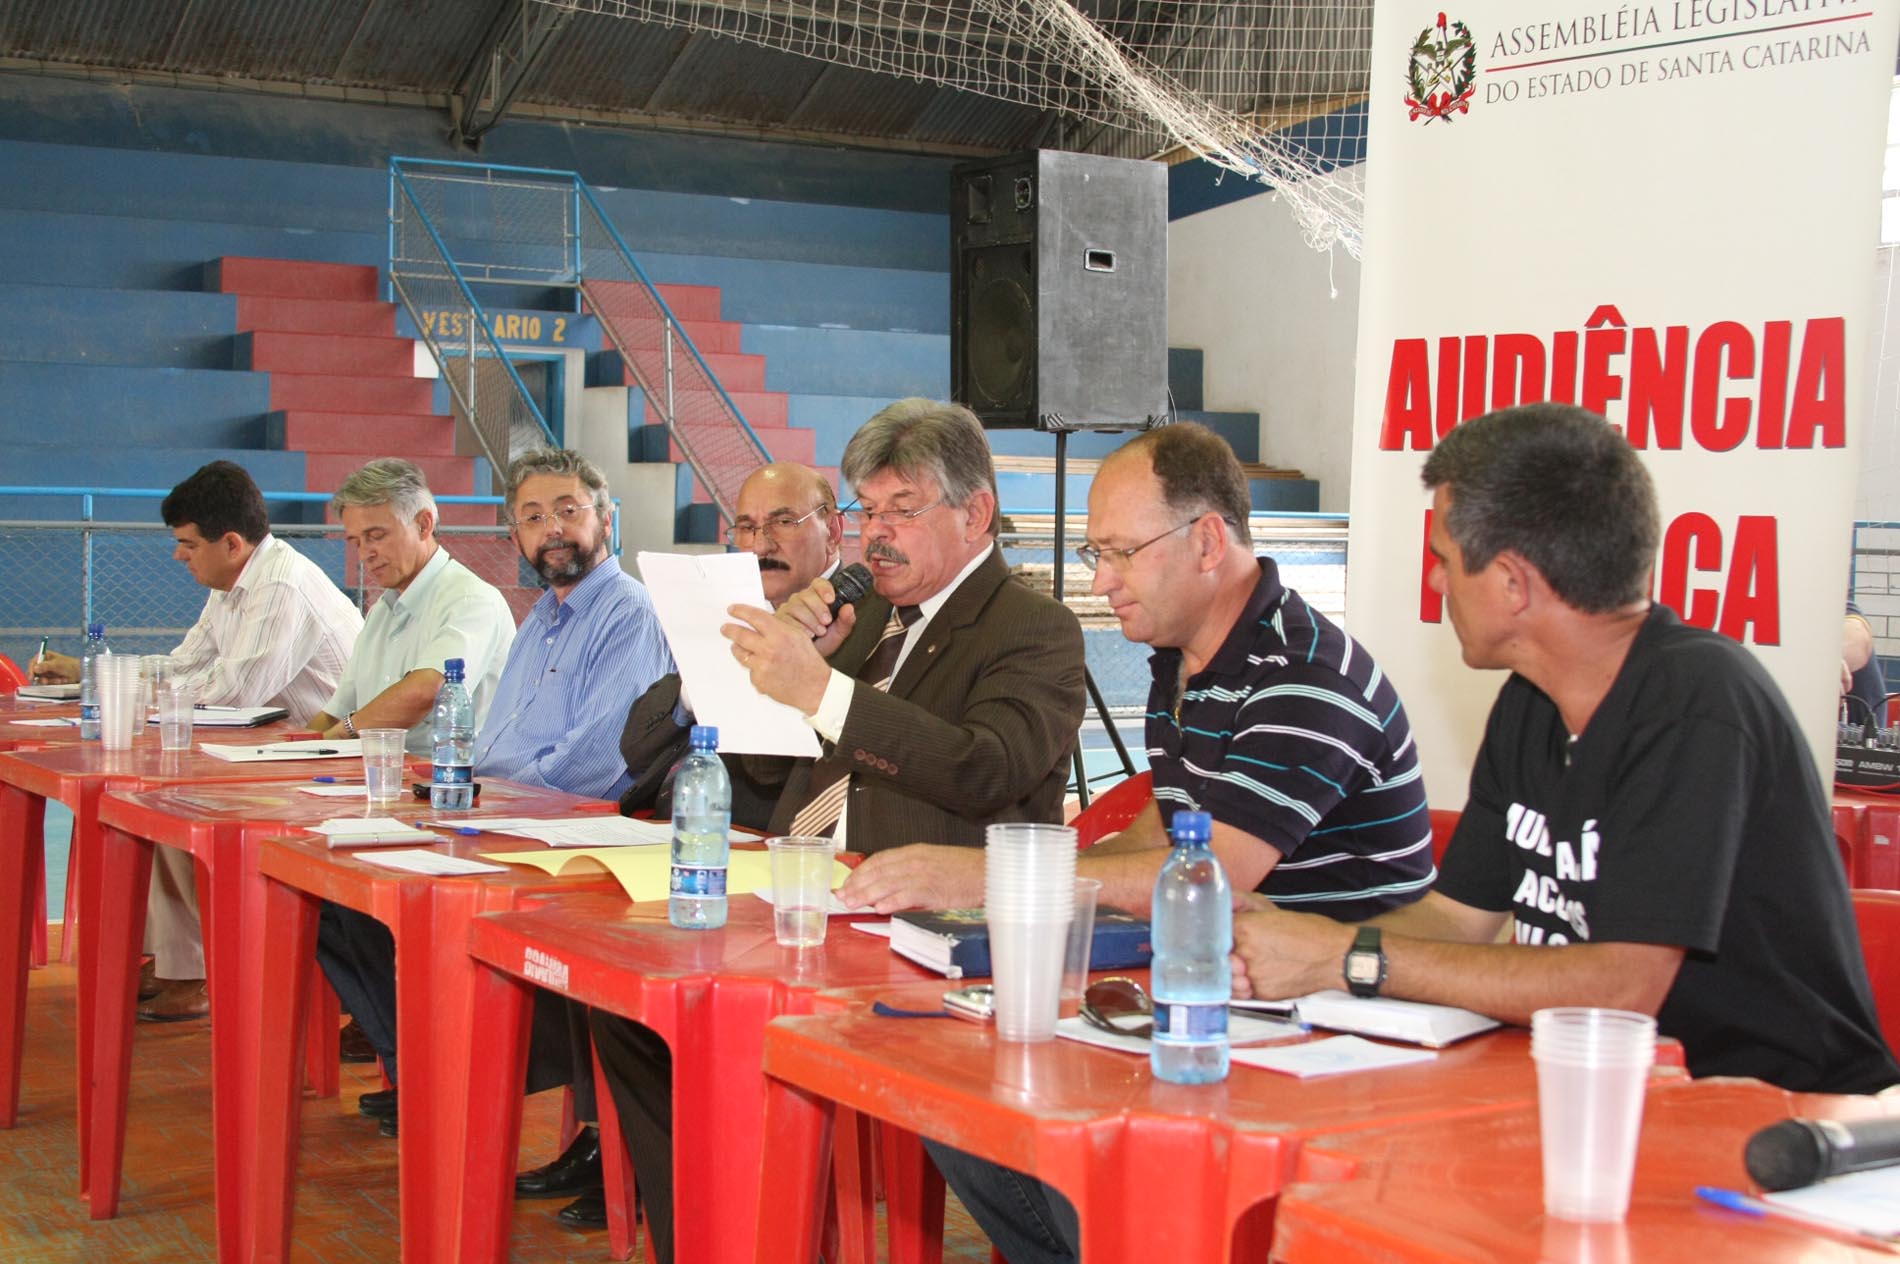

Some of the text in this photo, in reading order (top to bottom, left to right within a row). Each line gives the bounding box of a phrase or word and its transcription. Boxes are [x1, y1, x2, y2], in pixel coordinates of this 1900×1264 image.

[1490, 0, 1858, 59] ASSEMBLÉIA LEGISLA
[1486, 30, 1871, 105] DO ESTADO DE SANTA CATARINA
[422, 310, 567, 343] VESARIO 2
[1378, 304, 1846, 453] AUDIÊNCIA
